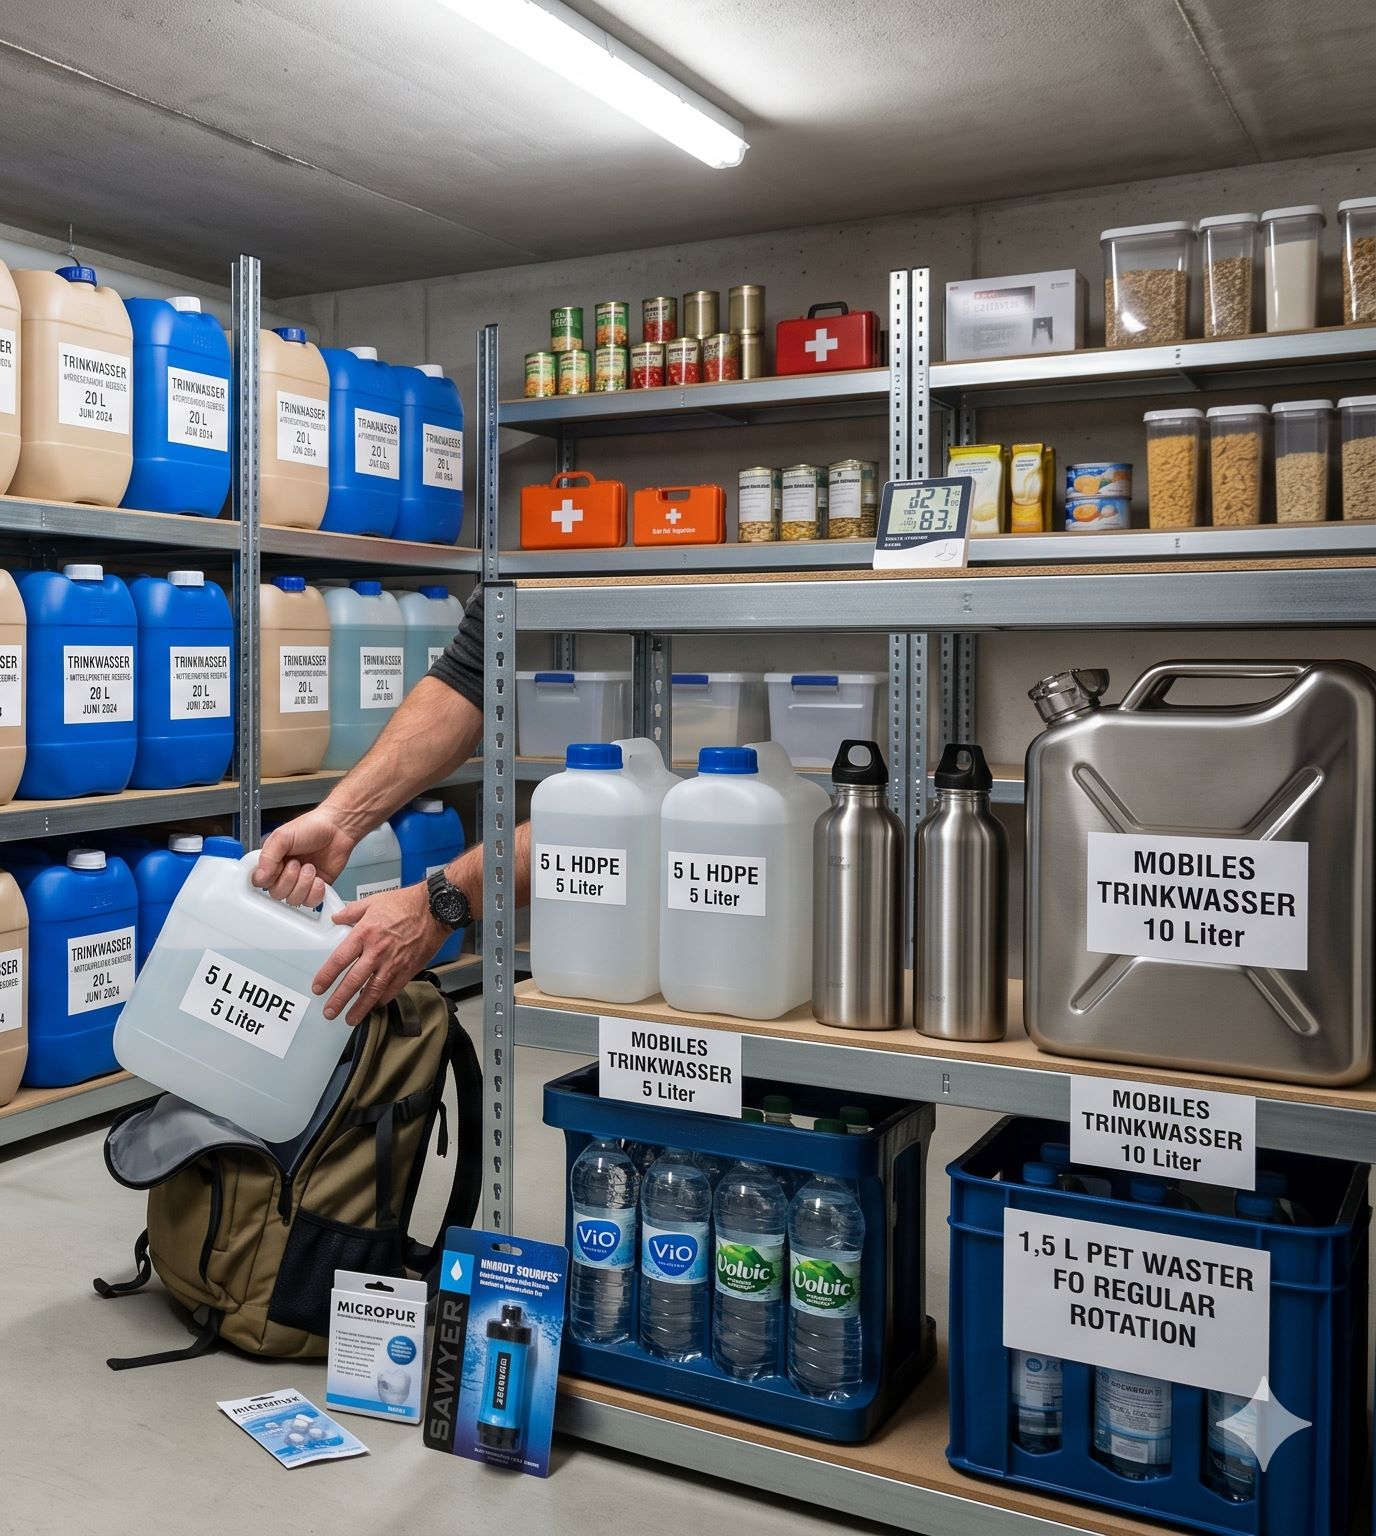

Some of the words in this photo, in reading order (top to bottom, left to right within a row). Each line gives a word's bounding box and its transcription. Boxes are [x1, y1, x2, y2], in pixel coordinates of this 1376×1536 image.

[63, 354, 126, 379] TRINKWASSER
[85, 390, 97, 405] 20
[101, 393, 105, 407] L
[172, 378, 225, 399] TRINKWASSER
[190, 411, 199, 424] 20
[203, 413, 207, 425] L
[297, 431, 305, 443] 20
[308, 433, 311, 444] L
[372, 445, 381, 457] 20
[68, 656, 130, 668] TRINKWASSER
[105, 687, 110, 699] L
[193, 685, 202, 697] 20
[205, 685, 209, 697] L
[299, 682, 306, 692] 20
[309, 682, 312, 692] L
[386, 680, 389, 689] L
[83, 704, 99, 714] JUNI
[541, 854, 550, 870] 5
[556, 855, 565, 872] L
[572, 855, 620, 875] HDPE
[674, 862, 683, 878] 5
[690, 863, 699, 880] L
[707, 864, 758, 885] HDPE
[1134, 851, 1255, 880] MOBILES
[556, 878, 564, 892] 5
[570, 879, 603, 896] Liter
[690, 888, 698, 902] 5
[704, 889, 739, 906] Liter
[1097, 881, 1295, 917] TRINKWASSER
[1144, 918, 1173, 942] 10
[1185, 921, 1245, 947] Liter
[72, 937, 131, 961] TRINKWASSER
[93, 973, 104, 987] 20
[107, 972, 112, 983] L
[205, 965, 220, 985] 5
[222, 973, 232, 994] L
[238, 981, 295, 1022] HDPE
[211, 998, 224, 1016] 5
[225, 1005, 265, 1035] Liter
[632, 1031, 708, 1056] MOBILES
[607, 1051, 732, 1084] TRINKWASSER
[643, 1081, 652, 1097] 5
[658, 1082, 695, 1102] Liter
[1113, 1090, 1210, 1120] MOBILES
[1082, 1112, 1242, 1151] TRINKWASSER
[1122, 1144, 1145, 1163] 10
[1154, 1148, 1202, 1172] Liter
[718, 1254, 770, 1280] Volvic
[1019, 1231, 1055, 1257] 1,5
[1065, 1238, 1078, 1261] L
[1088, 1242, 1134, 1270] PET
[1142, 1251, 1254, 1292] WASTER
[794, 1269, 851, 1296] Volvic
[1054, 1268, 1085, 1294] FO
[1094, 1275, 1215, 1319] REGULAR
[338, 1301, 416, 1322] MICROPUR
[1070, 1303, 1196, 1348] ROTATION
[430, 1300, 464, 1441] SAWYER
